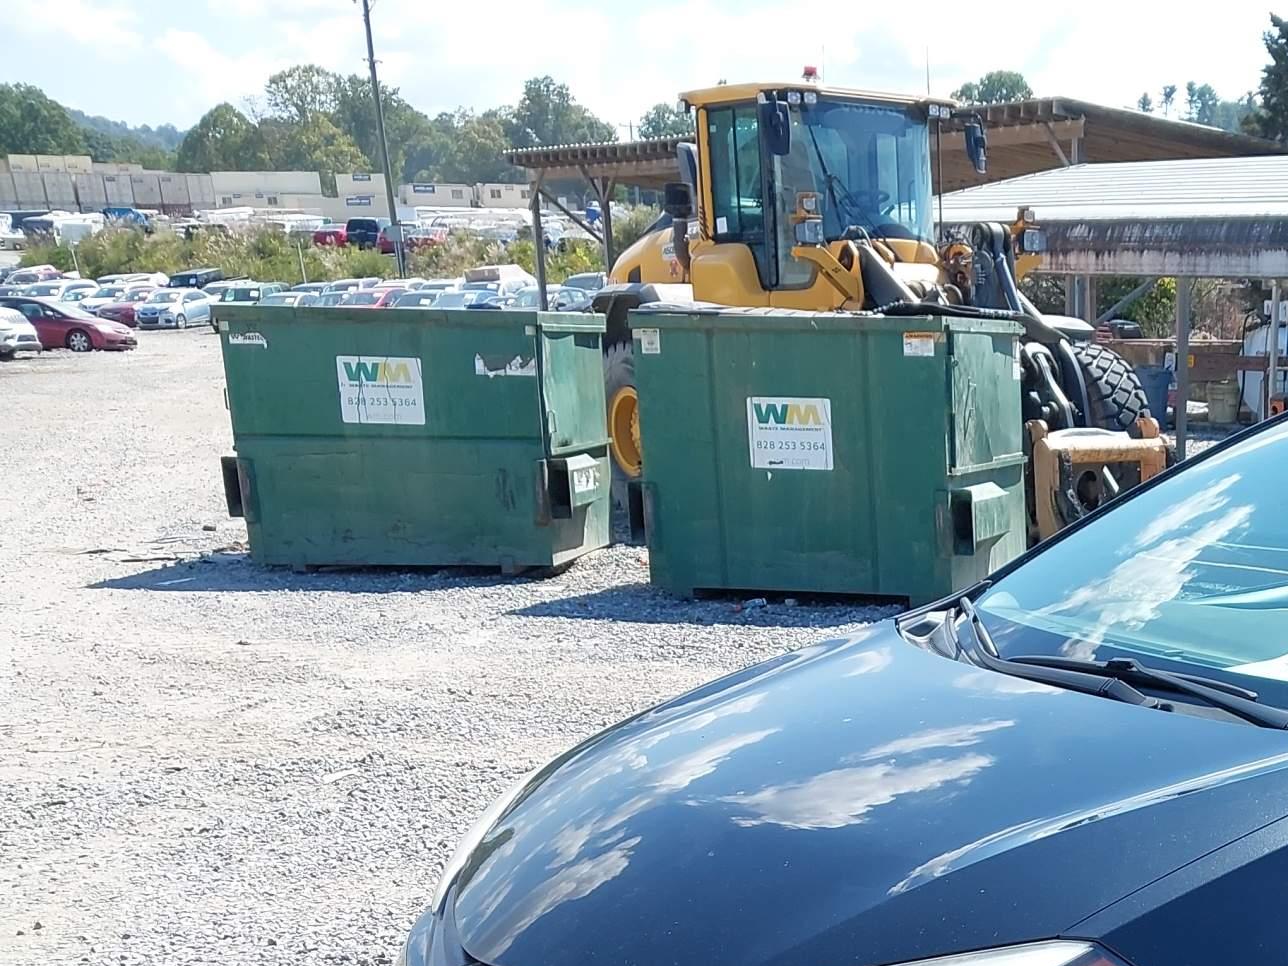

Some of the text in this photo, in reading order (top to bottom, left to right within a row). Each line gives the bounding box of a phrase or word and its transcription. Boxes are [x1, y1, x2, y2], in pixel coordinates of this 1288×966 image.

[343, 361, 412, 383] WM
[347, 396, 417, 407] 828 253 5364
[753, 402, 822, 426] WM
[756, 440, 825, 451] 828 253 5364
